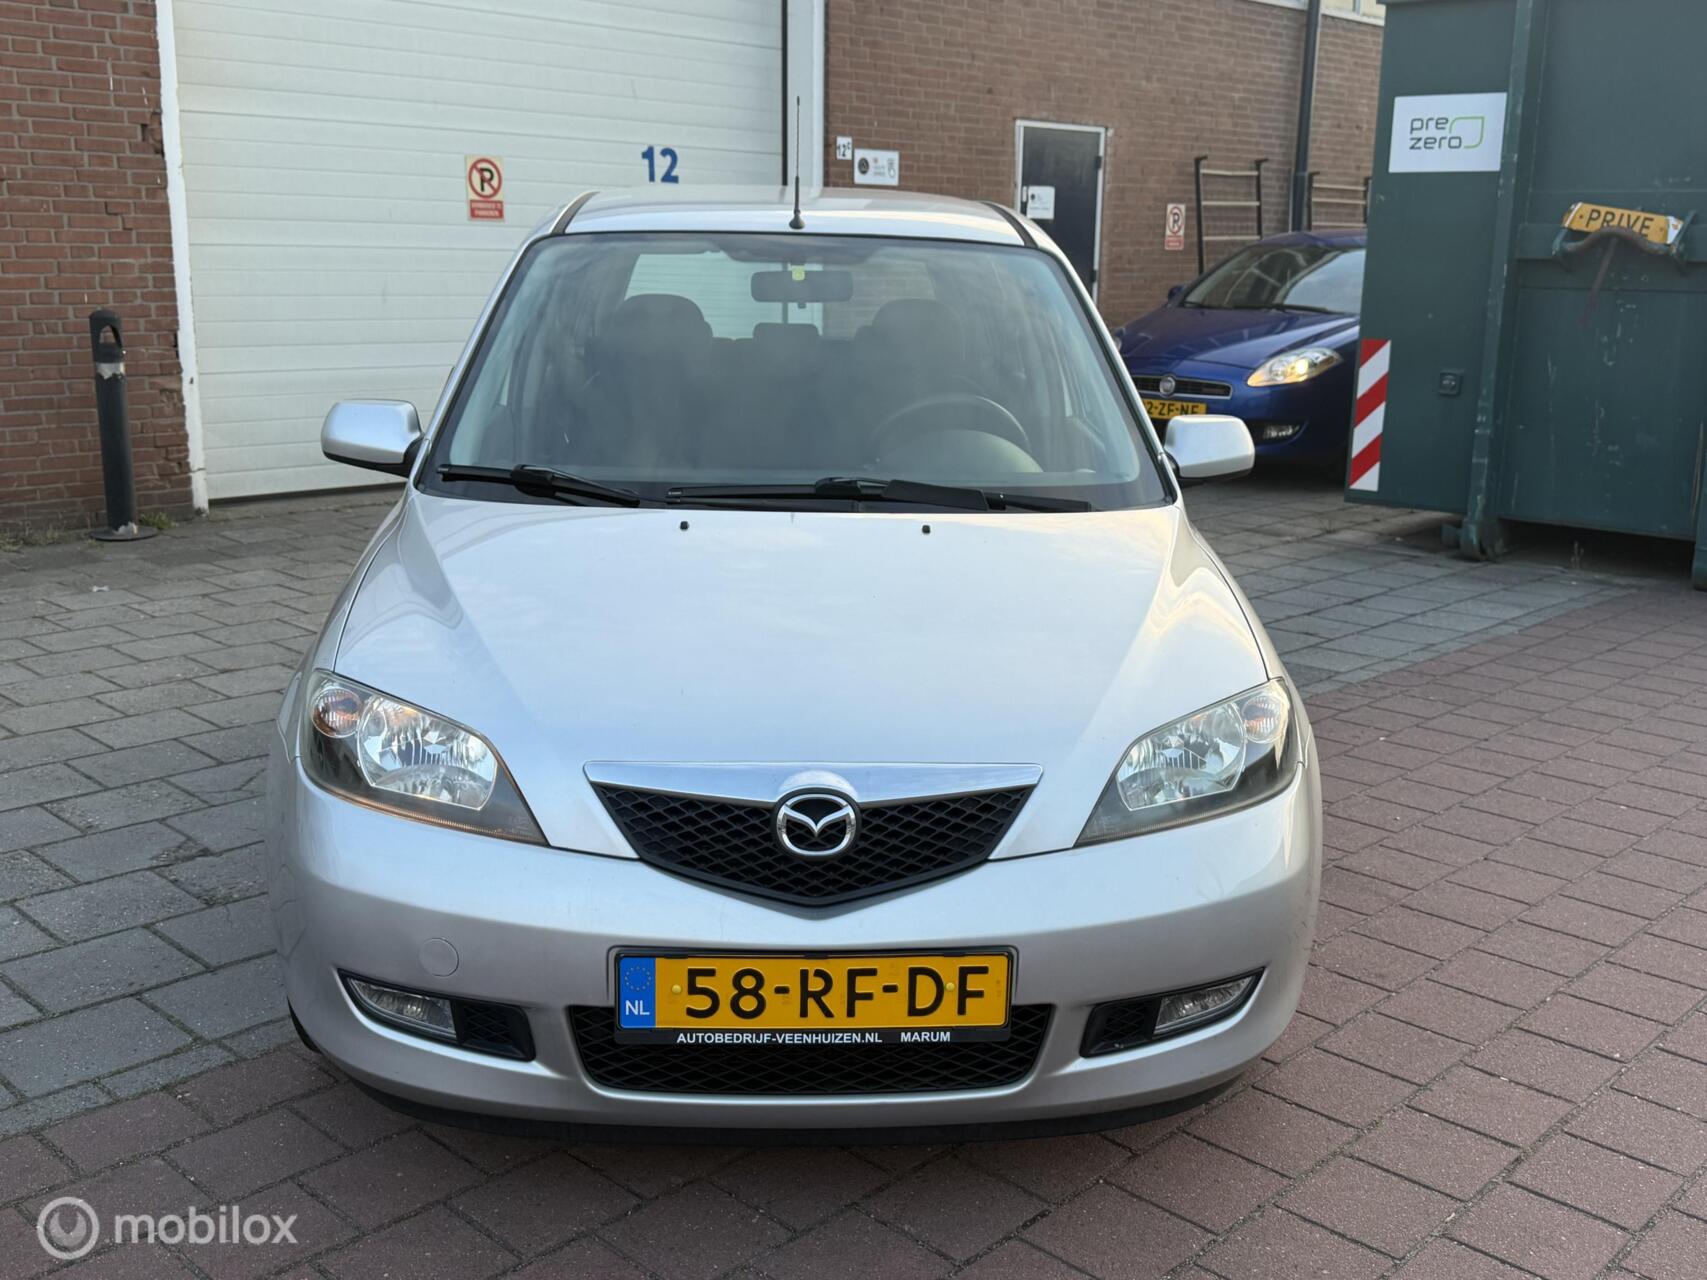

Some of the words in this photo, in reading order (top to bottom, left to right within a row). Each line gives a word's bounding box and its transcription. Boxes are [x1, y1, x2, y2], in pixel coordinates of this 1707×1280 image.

[1410, 116, 1448, 134] pre
[1409, 135, 1462, 150] zero
[641, 145, 679, 184] 12
[1585, 208, 1655, 237] PRIVE
[625, 999, 650, 1016] NL
[685, 965, 990, 1019] 58-RF-DF
[676, 1032, 882, 1044] AUTOBEDRIJF-VEENHUIZEN.NL
[900, 1031, 951, 1043] MARUM
